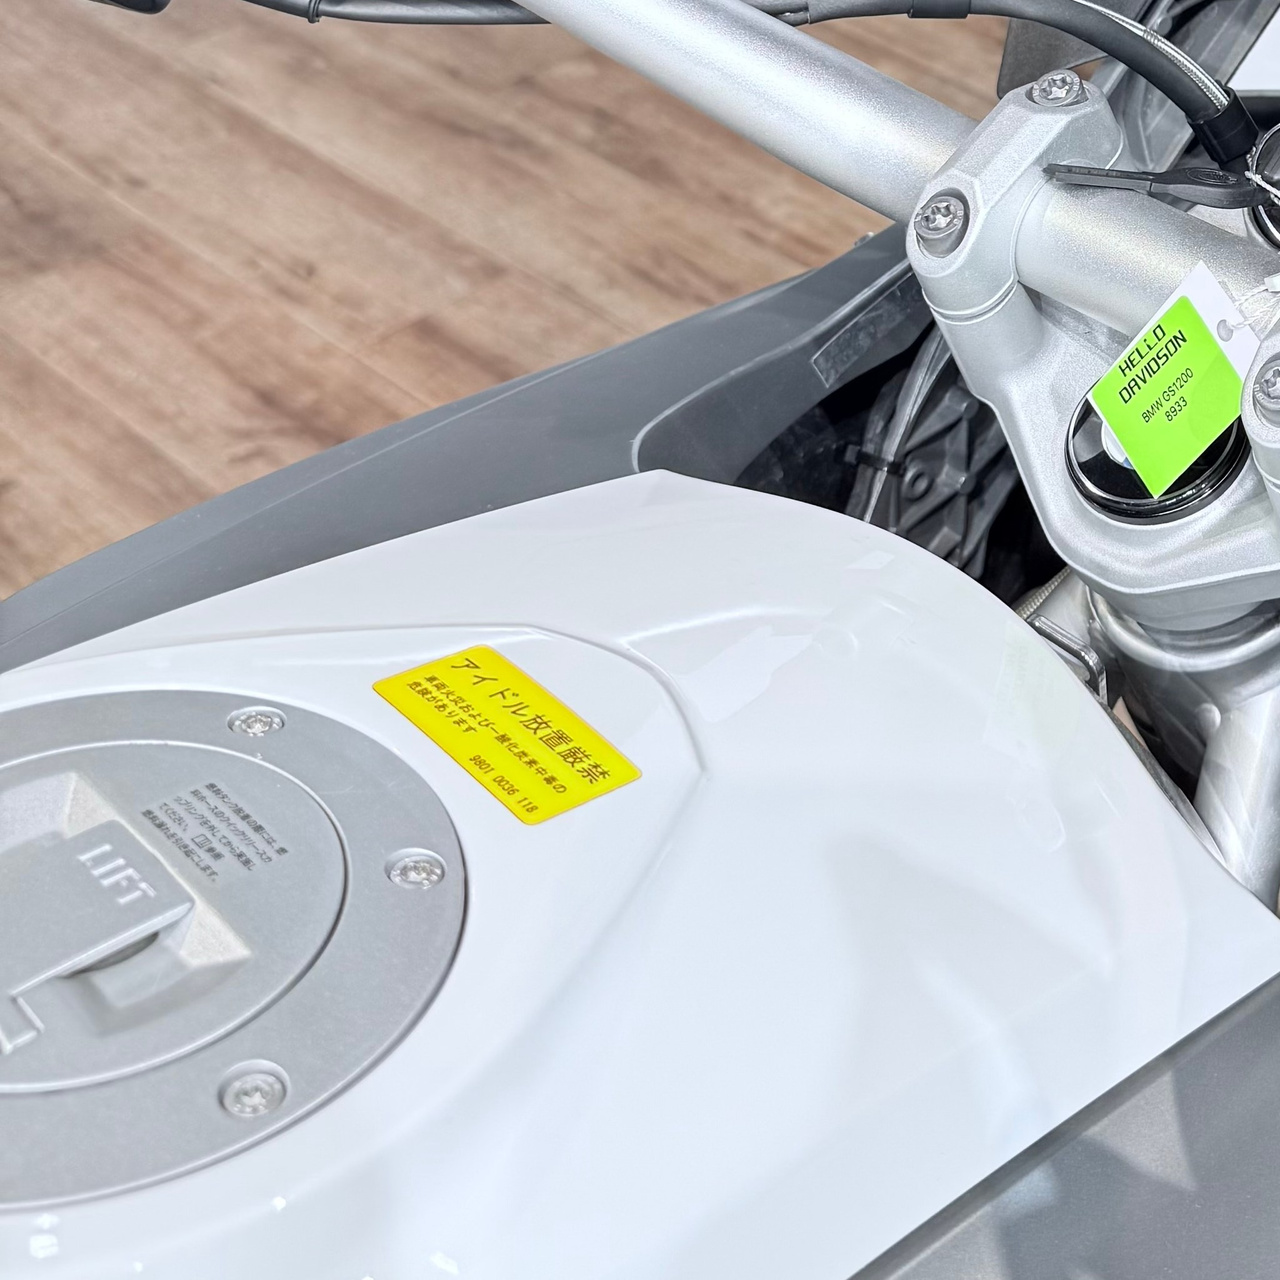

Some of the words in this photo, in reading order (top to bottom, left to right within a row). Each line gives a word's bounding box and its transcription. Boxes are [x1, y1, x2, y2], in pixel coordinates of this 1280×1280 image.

[1118, 324, 1166, 377] HELLO
[1118, 329, 1187, 404] DAVIDSON
[1141, 397, 1164, 423] BMW
[1161, 367, 1194, 402] GS1200
[1164, 396, 1188, 422] 8933
[406, 681, 478, 734] 危険があります
[450, 657, 611, 785] アイドル放置厳禁
[469, 754, 495, 775] 9801
[492, 775, 520, 796] 0036
[516, 796, 539, 814] 118
[77, 843, 157, 904] LIFT
